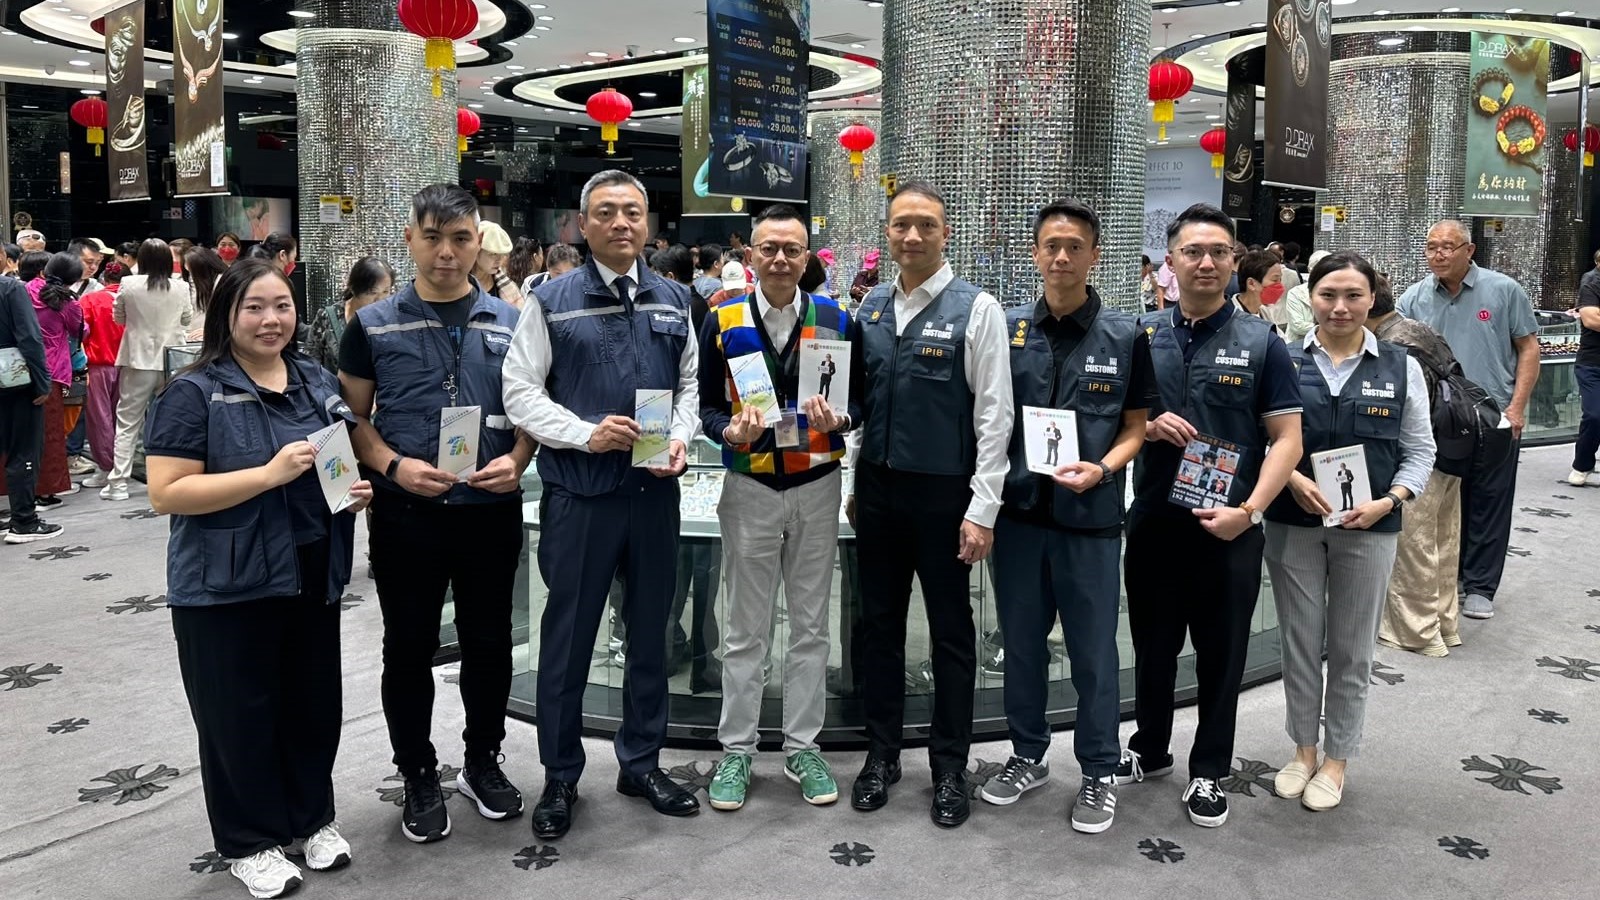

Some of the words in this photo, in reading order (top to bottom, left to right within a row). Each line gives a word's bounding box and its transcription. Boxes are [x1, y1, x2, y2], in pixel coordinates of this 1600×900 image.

[922, 328, 953, 339] CUSTOMS
[922, 346, 944, 357] IPIB
[1215, 356, 1249, 367] CUSTOMS
[1085, 364, 1118, 375] CUSTOMS
[1219, 374, 1242, 385] IPIB
[1088, 382, 1111, 392] IPIB
[1361, 388, 1395, 399] CUSTOMS
[1367, 406, 1389, 417] IPIB
